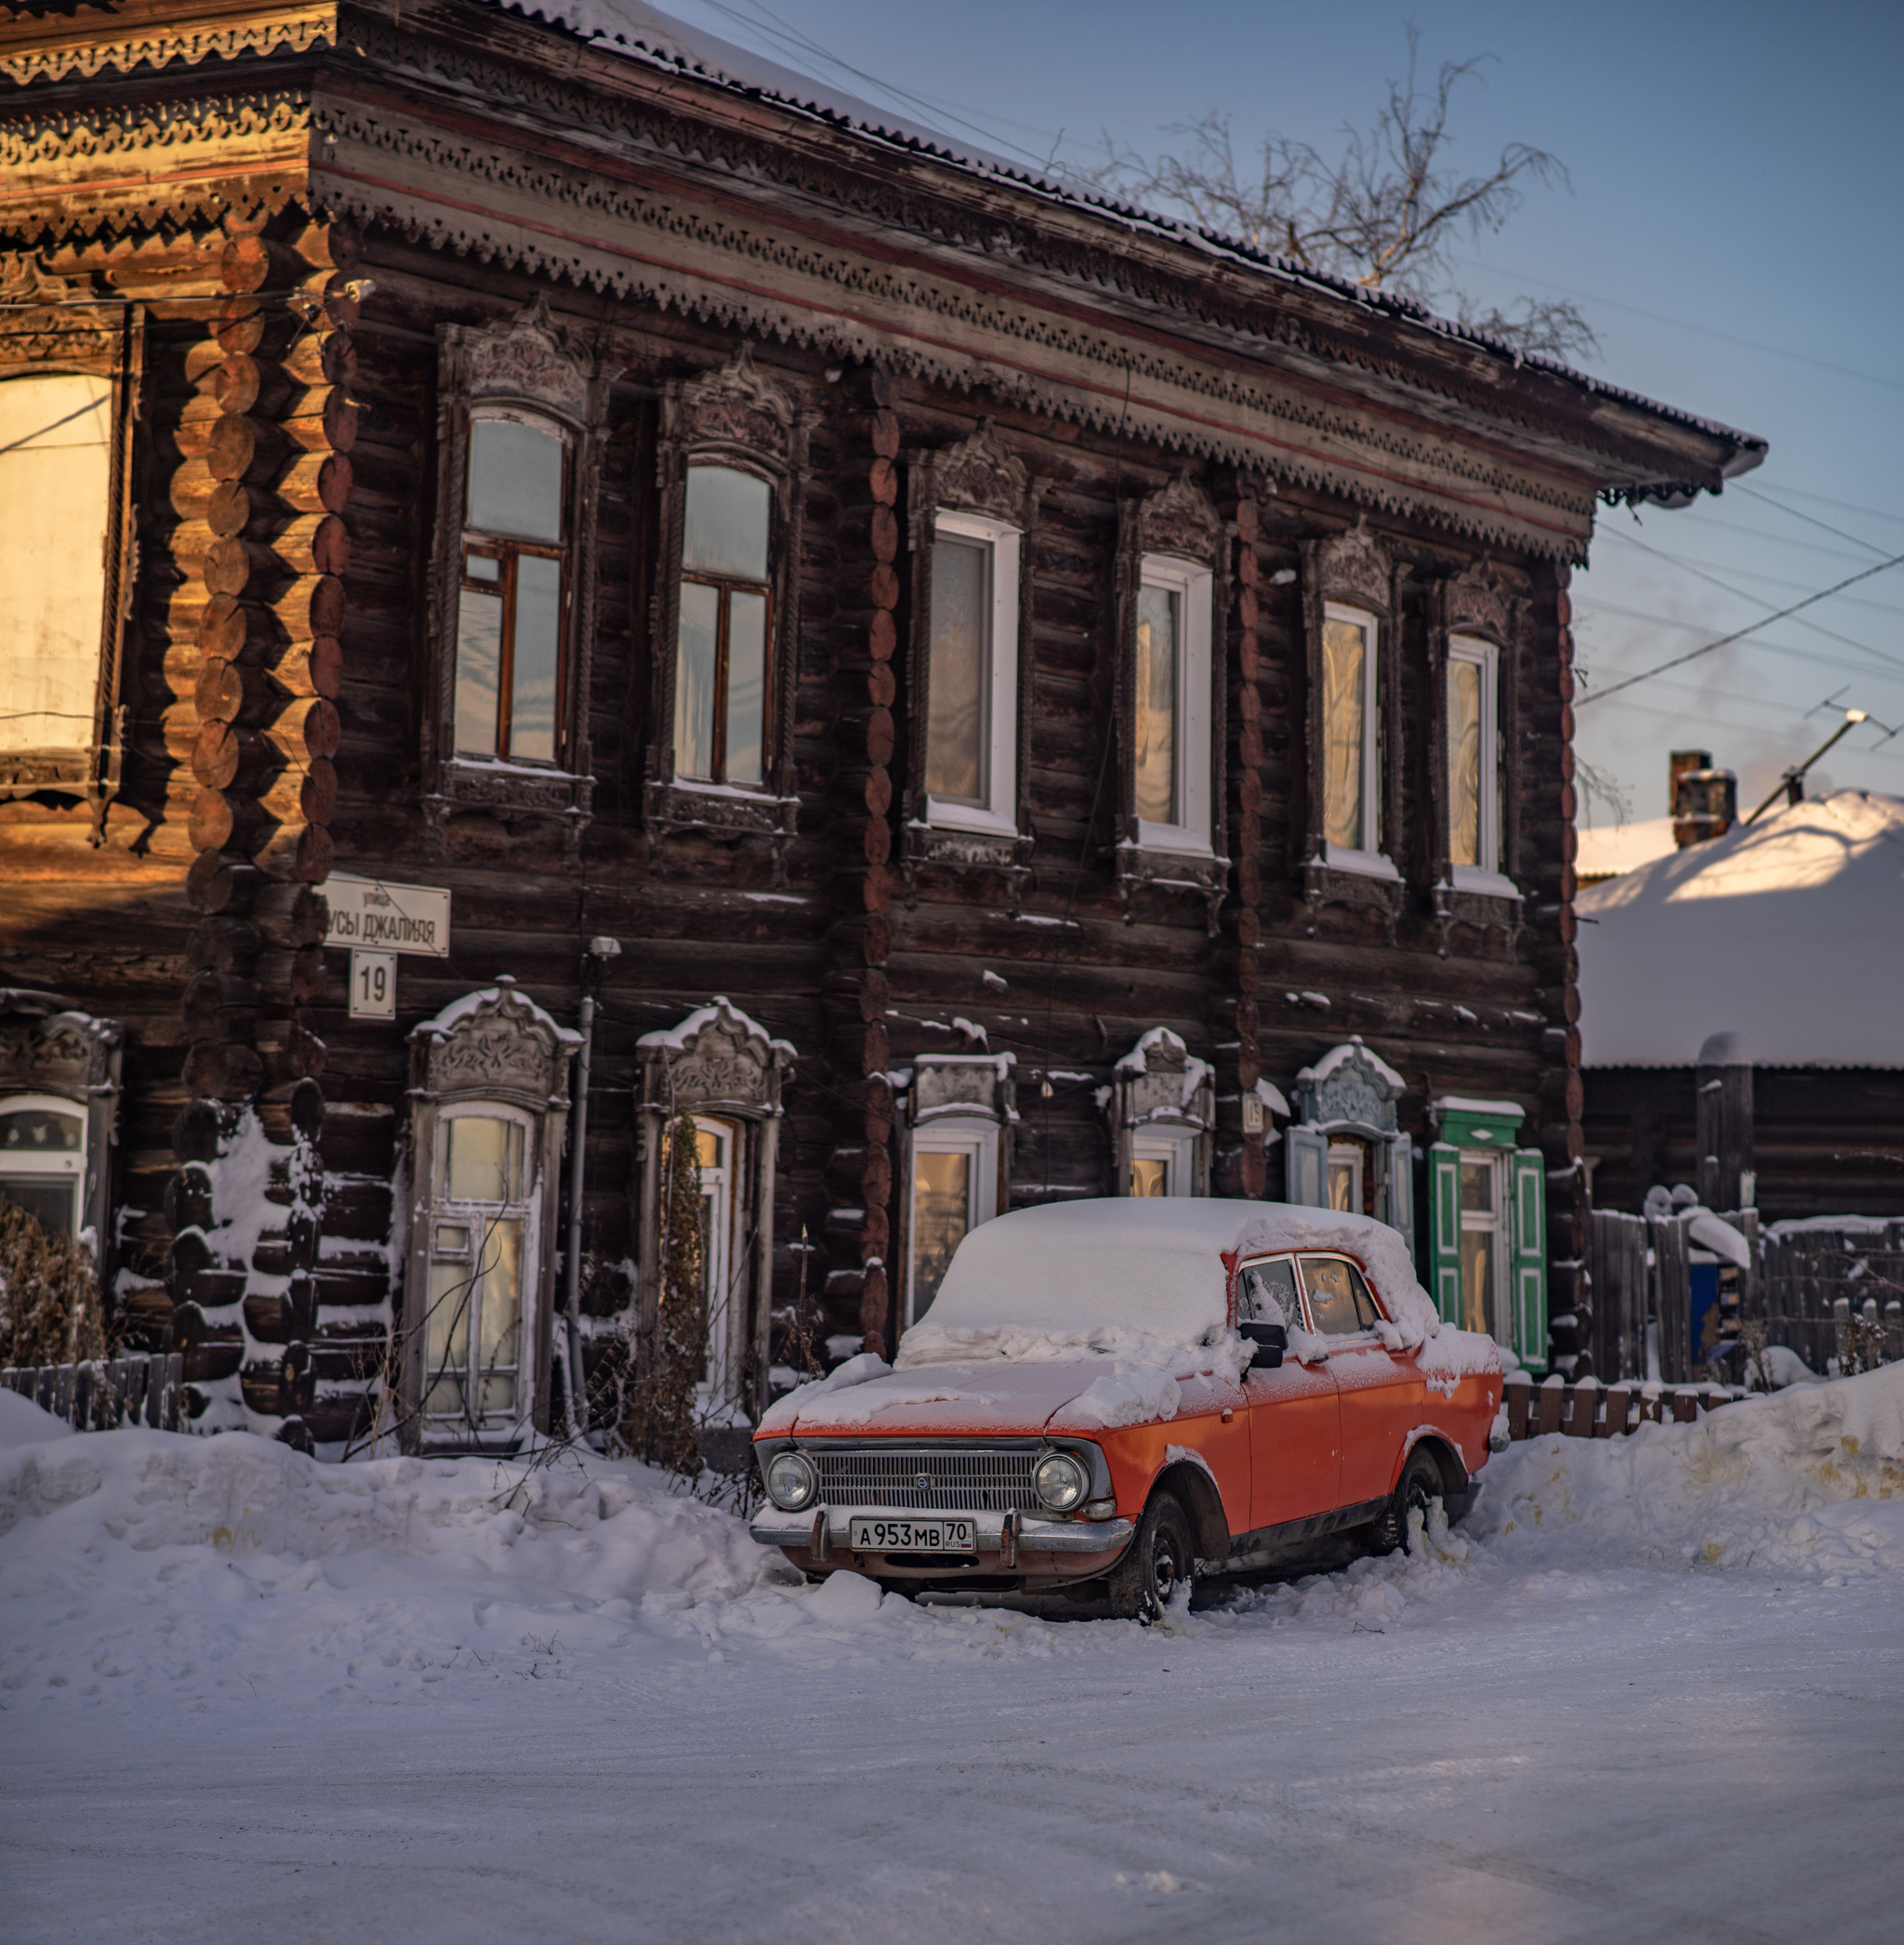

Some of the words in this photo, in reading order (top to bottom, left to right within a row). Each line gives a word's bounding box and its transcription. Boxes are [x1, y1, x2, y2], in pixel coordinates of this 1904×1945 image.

[364, 892, 390, 908] улица
[328, 909, 360, 936] УСЫ
[363, 913, 435, 944] ДЖАЛИЛЯ
[361, 965, 386, 1002] 19
[945, 1523, 967, 1541] 70
